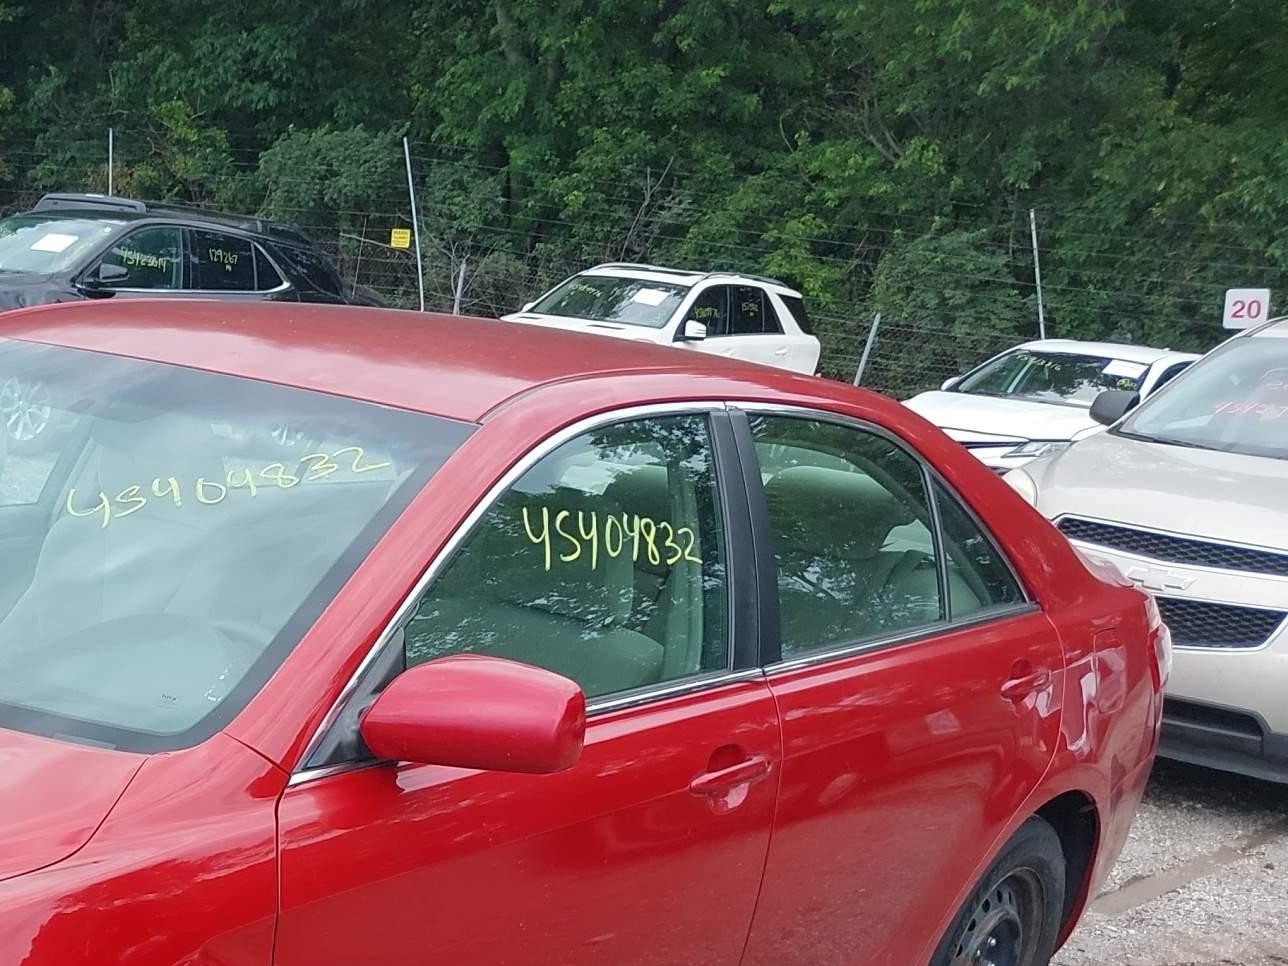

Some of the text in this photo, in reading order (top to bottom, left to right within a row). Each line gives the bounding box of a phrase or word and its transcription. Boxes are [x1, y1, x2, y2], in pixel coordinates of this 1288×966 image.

[1231, 300, 1262, 319] 20
[66, 445, 392, 529] 45404832
[522, 505, 704, 573] 45404832
